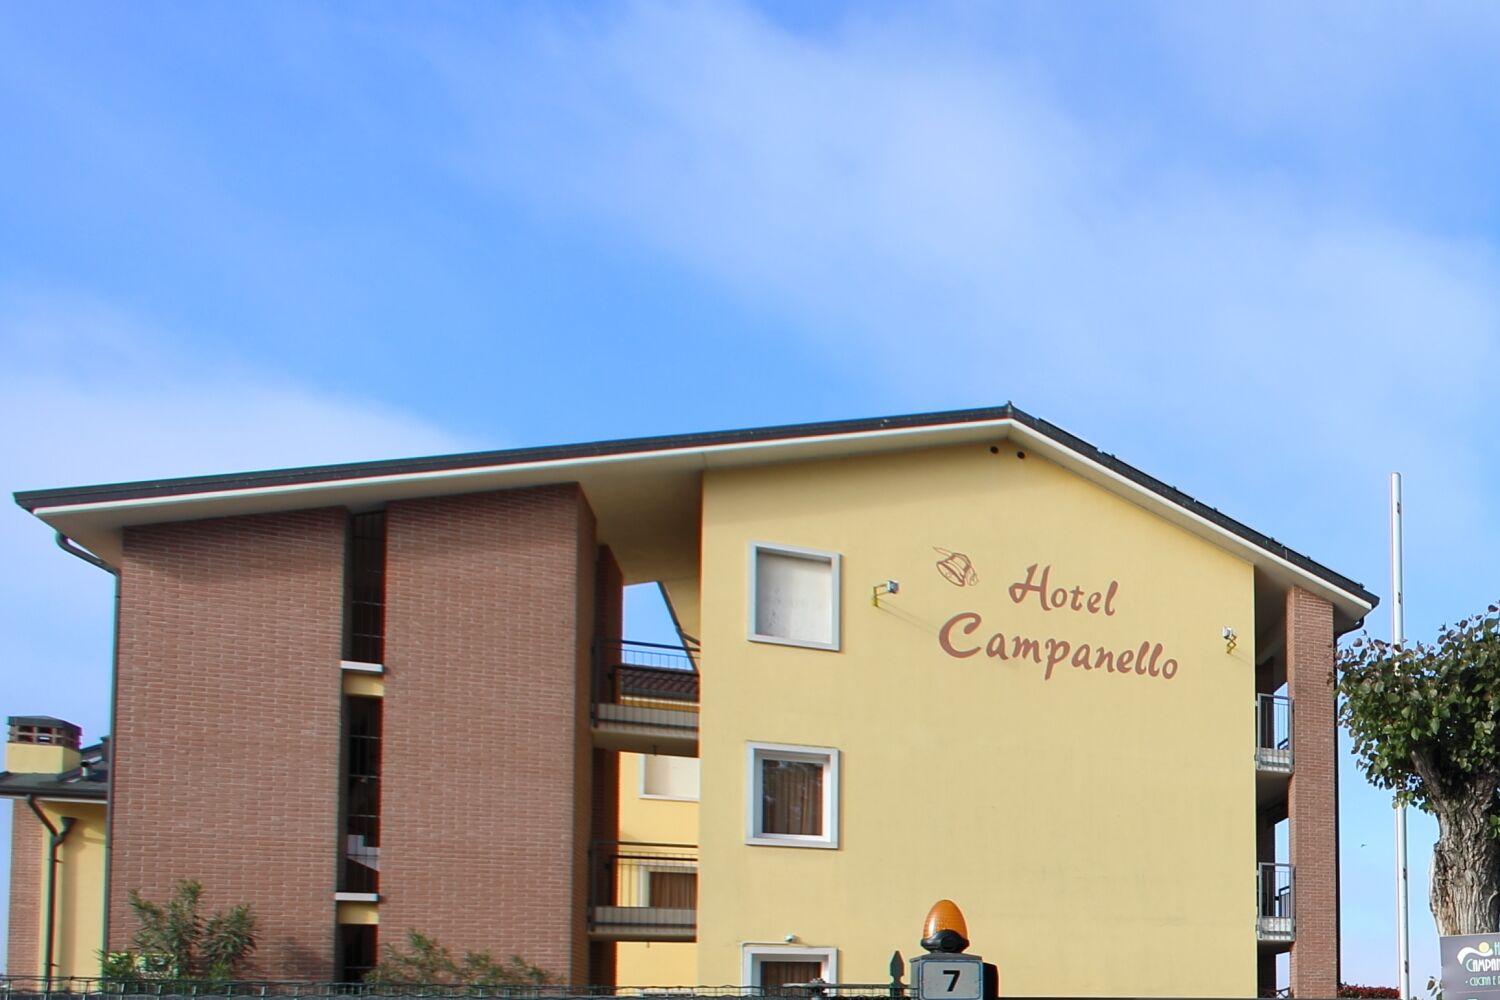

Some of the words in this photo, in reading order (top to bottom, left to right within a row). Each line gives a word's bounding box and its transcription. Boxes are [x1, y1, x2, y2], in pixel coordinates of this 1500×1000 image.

[1008, 563, 1119, 617] Hotel
[938, 612, 1178, 681] Campanello
[943, 970, 960, 992] 7
[1470, 976, 1491, 986] CUCINA
[1493, 976, 1496, 985] E
